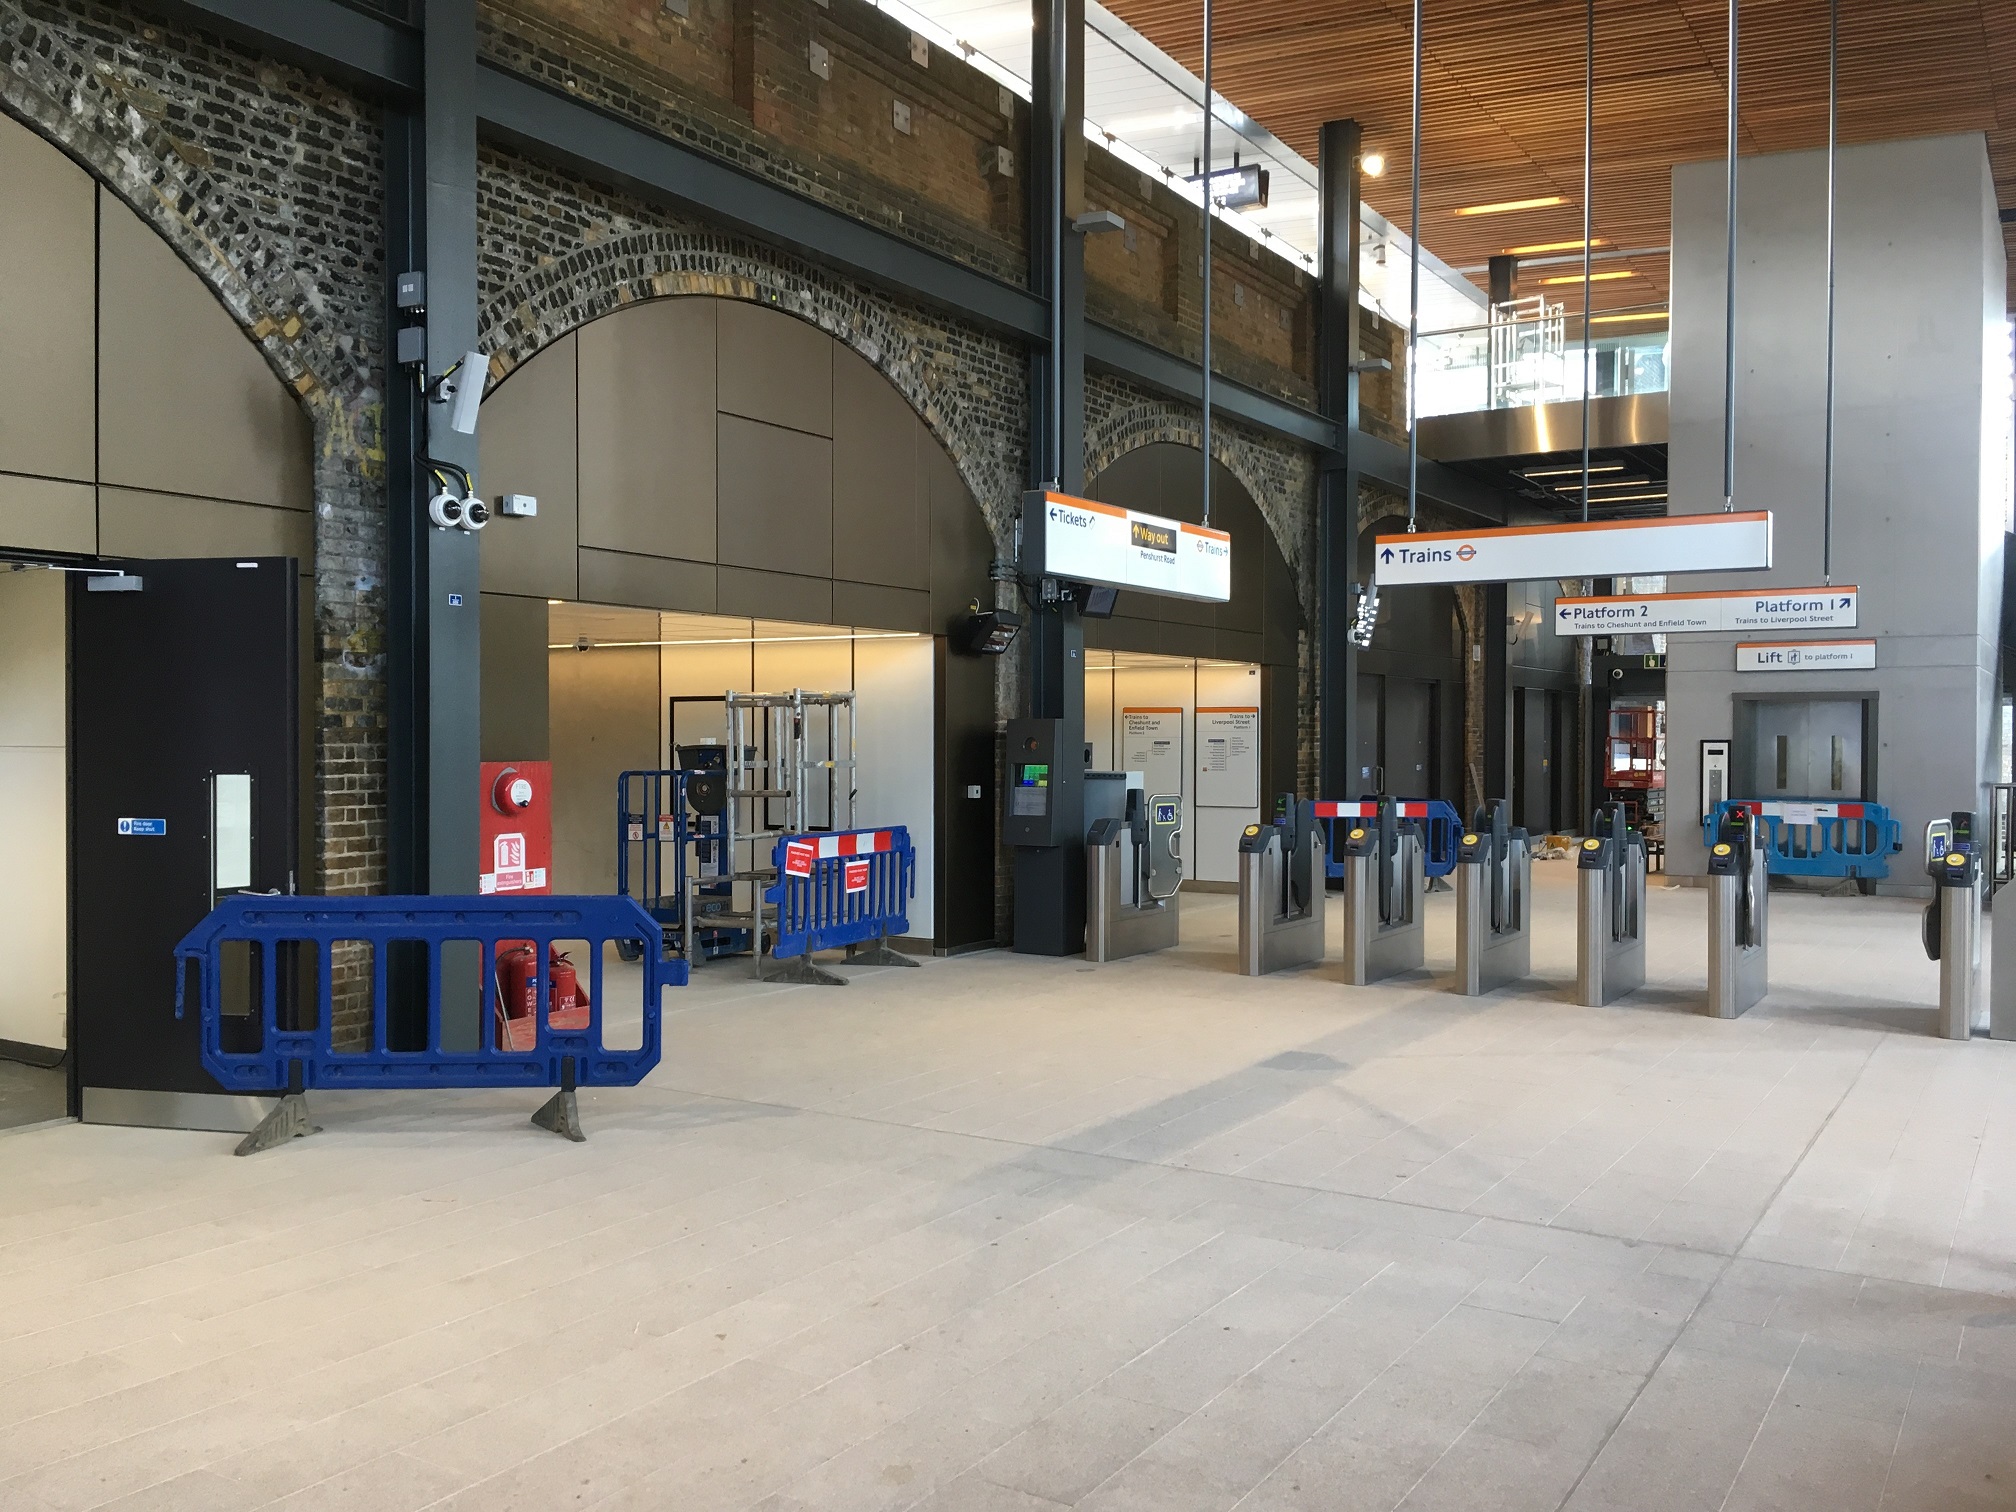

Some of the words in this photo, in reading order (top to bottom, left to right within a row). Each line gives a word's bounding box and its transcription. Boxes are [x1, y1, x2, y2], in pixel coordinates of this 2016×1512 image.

[1058, 509, 1087, 528] Tickets
[1140, 526, 1156, 545] Way
[1156, 533, 1169, 545] out
[1205, 541, 1223, 557] Trains
[1399, 547, 1452, 563] Trains
[1140, 550, 1163, 563] Penshurst
[1163, 554, 1175, 565] Road
[1573, 606, 1635, 619] Platform
[1640, 605, 1648, 617] 2
[1755, 599, 1823, 613] Platform
[1574, 622, 1595, 630] Trains
[1606, 621, 1642, 629] Cheshunt
[1659, 619, 1685, 627] Enfield
[1735, 616, 1758, 624] Trains
[1770, 615, 1807, 624] Liverpool
[1757, 651, 1783, 664] Lift
[1815, 653, 1848, 661] platform
